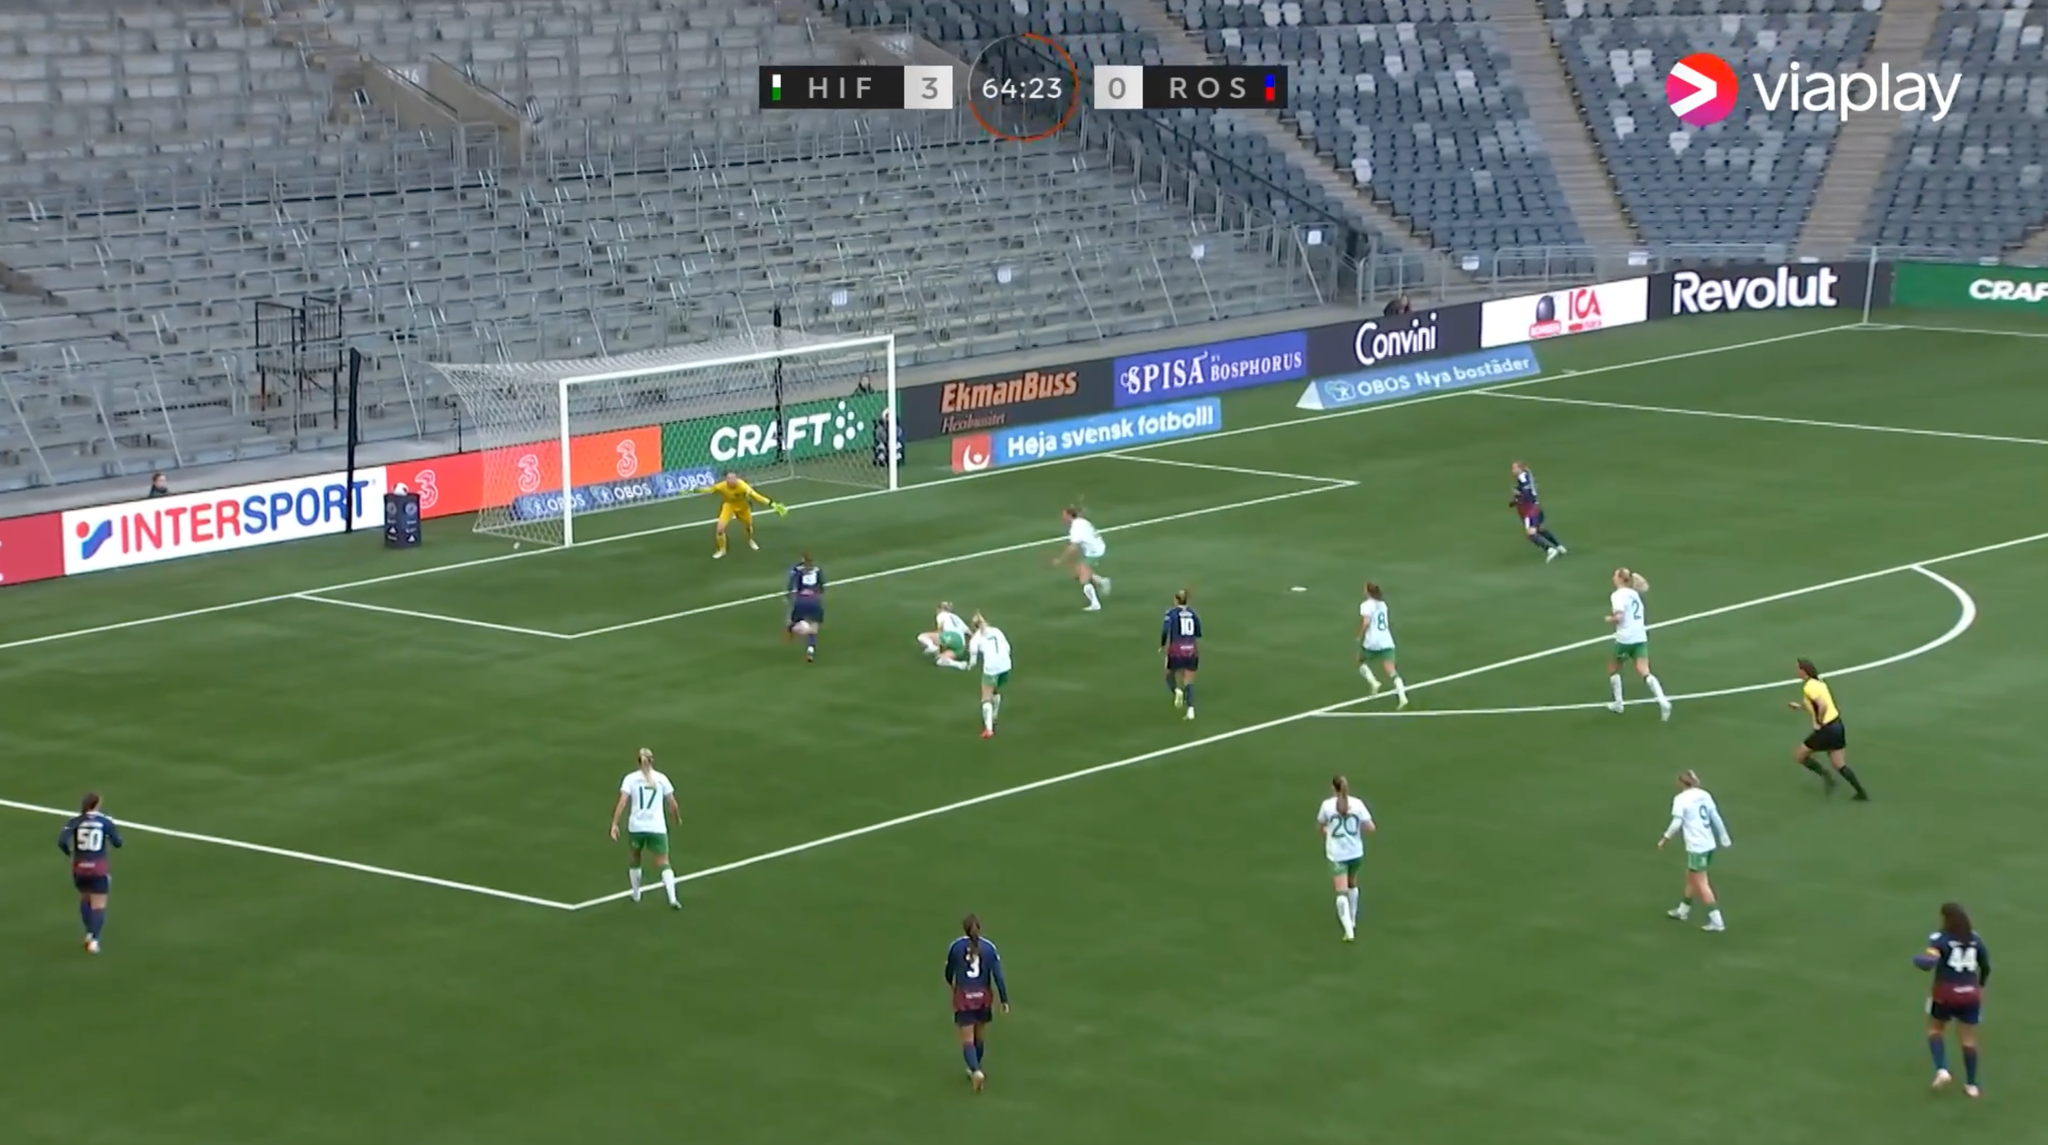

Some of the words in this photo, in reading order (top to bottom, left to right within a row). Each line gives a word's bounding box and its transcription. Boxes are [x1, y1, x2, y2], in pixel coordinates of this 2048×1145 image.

[1672, 265, 1839, 315] Revolut
[1568, 289, 1602, 321] ICA
[1355, 312, 1438, 366] Convini
[1120, 351, 1208, 395] SPISA
[1211, 351, 1303, 382] BOSPHORUS
[1357, 375, 1410, 397] OBOS
[1415, 371, 1451, 388] Nya
[1453, 358, 1530, 381] bostäder
[941, 371, 1078, 414] EkmanBuss
[710, 412, 832, 462] CRAFT
[1008, 431, 1058, 458] Heja
[1061, 418, 1134, 449] svensk
[613, 482, 652, 501] OBOS
[678, 471, 716, 490] OBOS
[120, 480, 370, 554] INTERSPORT
[1377, 612, 1387, 631] 8
[1631, 600, 1642, 621] 2
[1179, 618, 1195, 636] 10
[987, 635, 999, 654] 7
[639, 786, 657, 810] 17
[1329, 813, 1360, 838] 20
[1698, 804, 1711, 829] 9
[76, 828, 104, 851] 50
[965, 953, 981, 978] 3
[1947, 946, 1979, 973] 44
